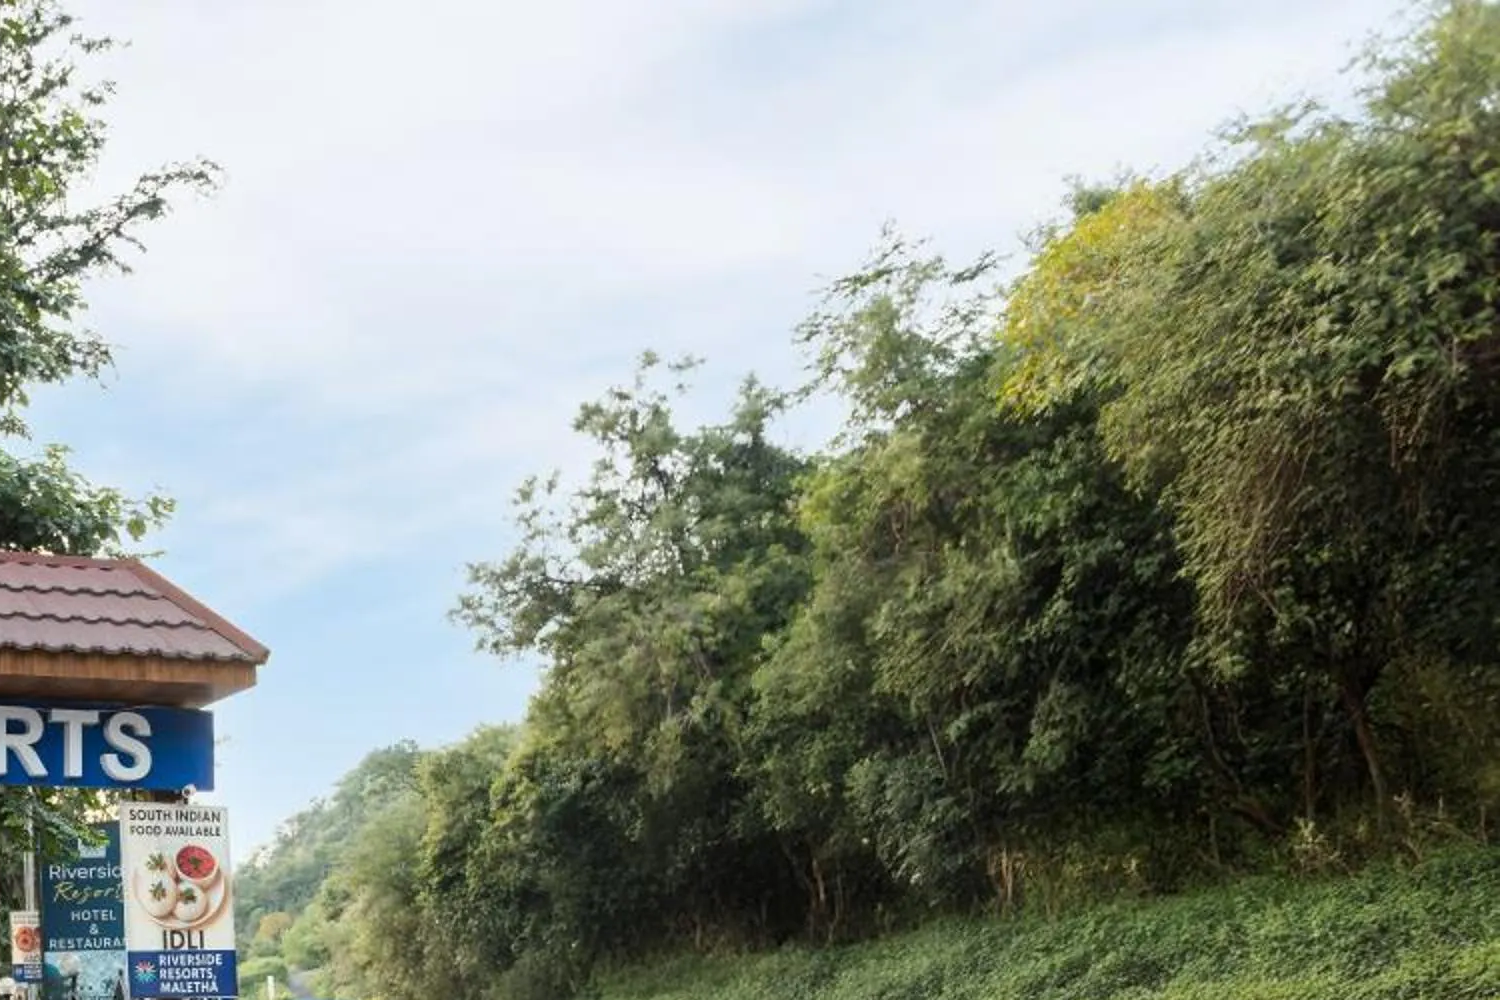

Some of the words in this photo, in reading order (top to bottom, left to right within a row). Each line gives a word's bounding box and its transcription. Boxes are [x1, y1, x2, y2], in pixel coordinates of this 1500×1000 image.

[129, 808, 172, 821] SOUTH
[175, 809, 221, 823] INDIAN
[130, 825, 162, 836] FOOD
[165, 825, 221, 837] AVAILABLE
[49, 861, 123, 880] Riversid
[71, 909, 117, 921] HOTEL
[89, 923, 99, 935] &
[49, 937, 124, 950] RESTAURA
[163, 930, 205, 949] IDLI
[159, 953, 223, 967] RIVERSIDE
[160, 967, 217, 981] RESORTS,
[160, 981, 219, 993] MALETHA
